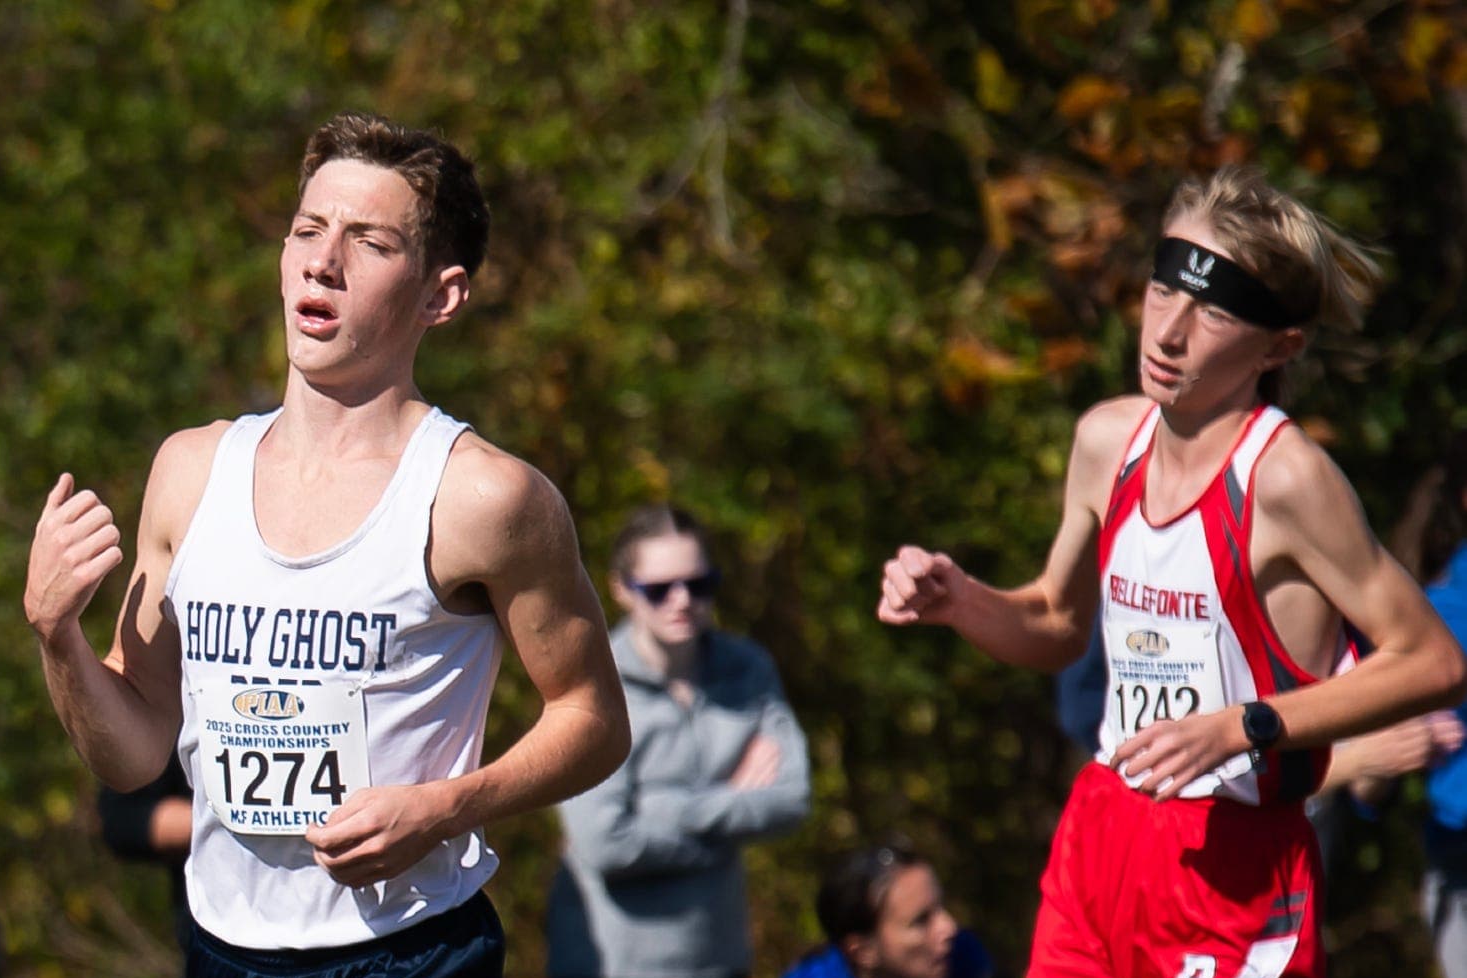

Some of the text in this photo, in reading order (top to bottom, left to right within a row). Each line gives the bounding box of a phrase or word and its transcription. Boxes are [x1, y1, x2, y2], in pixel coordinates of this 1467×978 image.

[1110, 574, 1210, 620] BELLEFONTE
[187, 601, 397, 672] HOLY GHOST
[241, 694, 299, 716] PIAA
[206, 719, 350, 736] 2025 CROSS COUNTRY
[220, 734, 330, 748] CHAMPIONSHIPS
[215, 748, 347, 806] 1274
[252, 811, 328, 826] ATHLETIC
